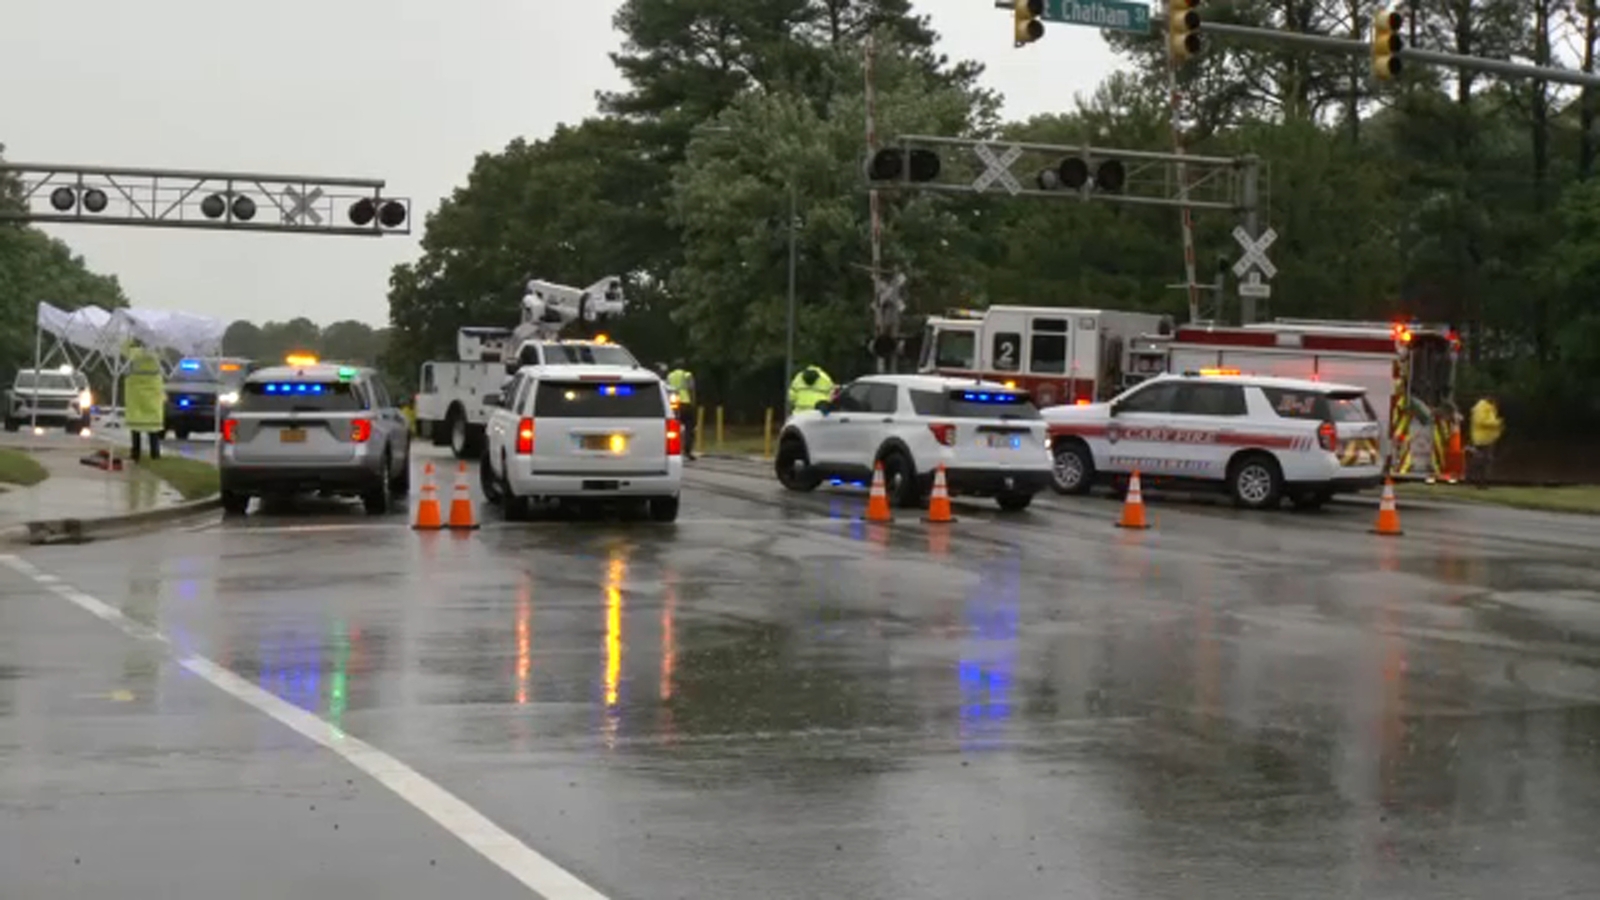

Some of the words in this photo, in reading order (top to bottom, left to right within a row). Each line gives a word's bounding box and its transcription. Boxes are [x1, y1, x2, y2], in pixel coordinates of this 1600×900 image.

[1061, 1, 1130, 26] Chatham
[1000, 341, 1014, 362] 2
[1123, 428, 1171, 442] CARY
[1173, 430, 1216, 444] FIRE
